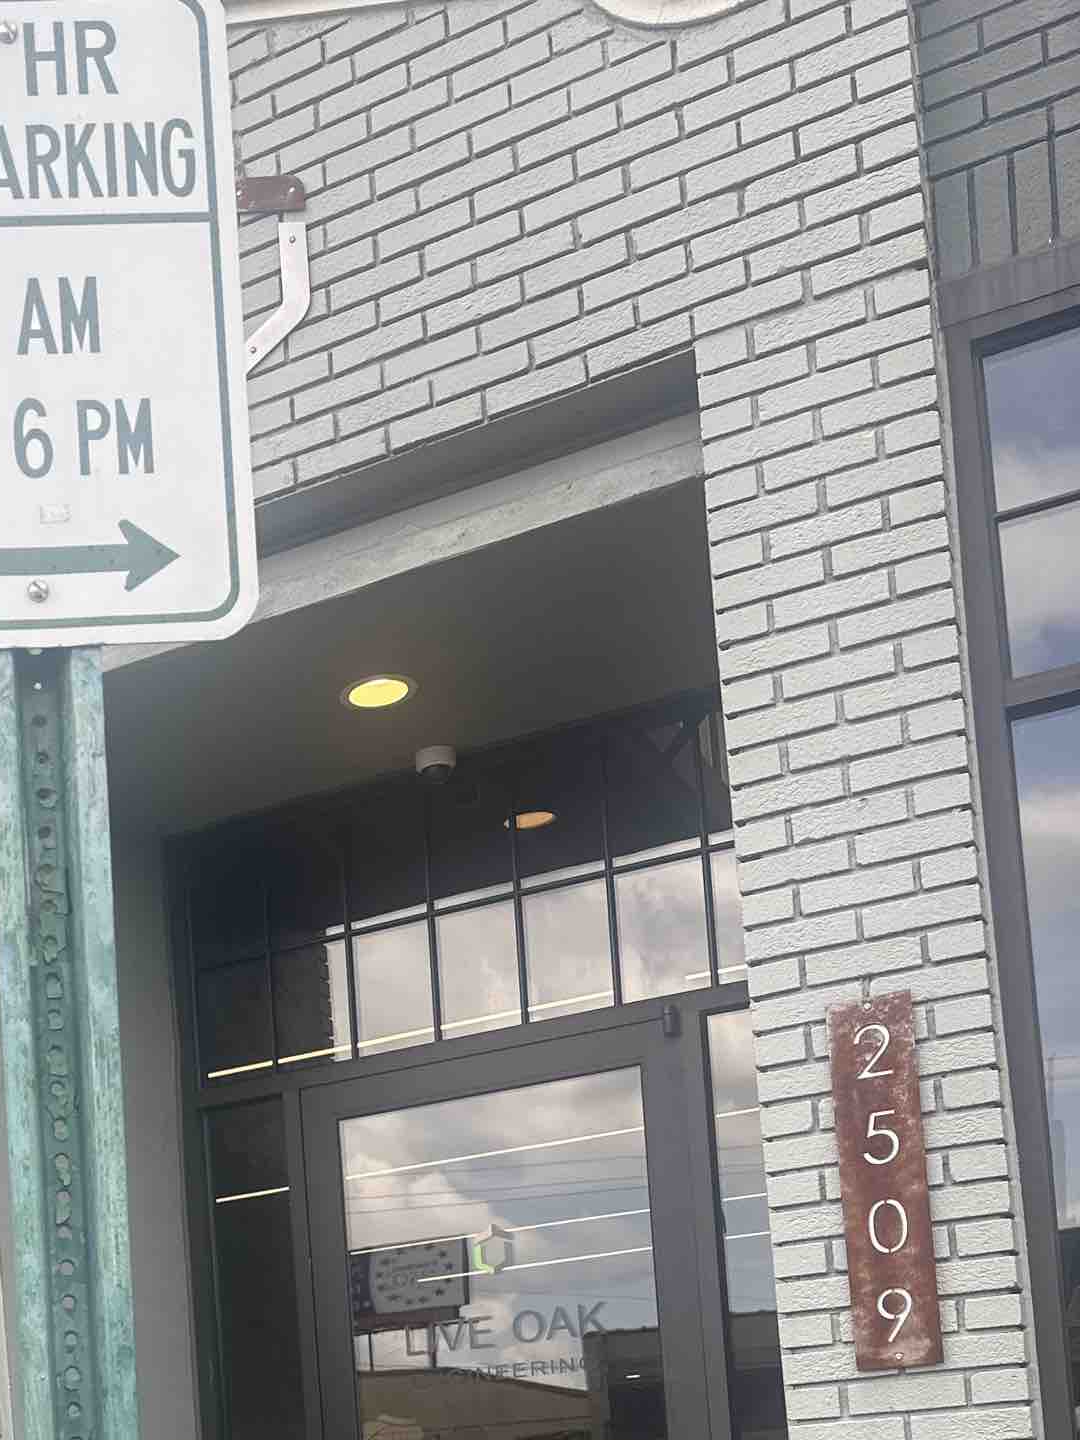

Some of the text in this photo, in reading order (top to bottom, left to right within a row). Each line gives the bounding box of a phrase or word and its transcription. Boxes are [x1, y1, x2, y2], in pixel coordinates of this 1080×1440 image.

[23, 20, 118, 97] HR
[17, 276, 101, 355] AM
[13, 398, 54, 479] 6
[76, 398, 155, 476] PM
[405, 1301, 608, 1356] LIVE OAK
